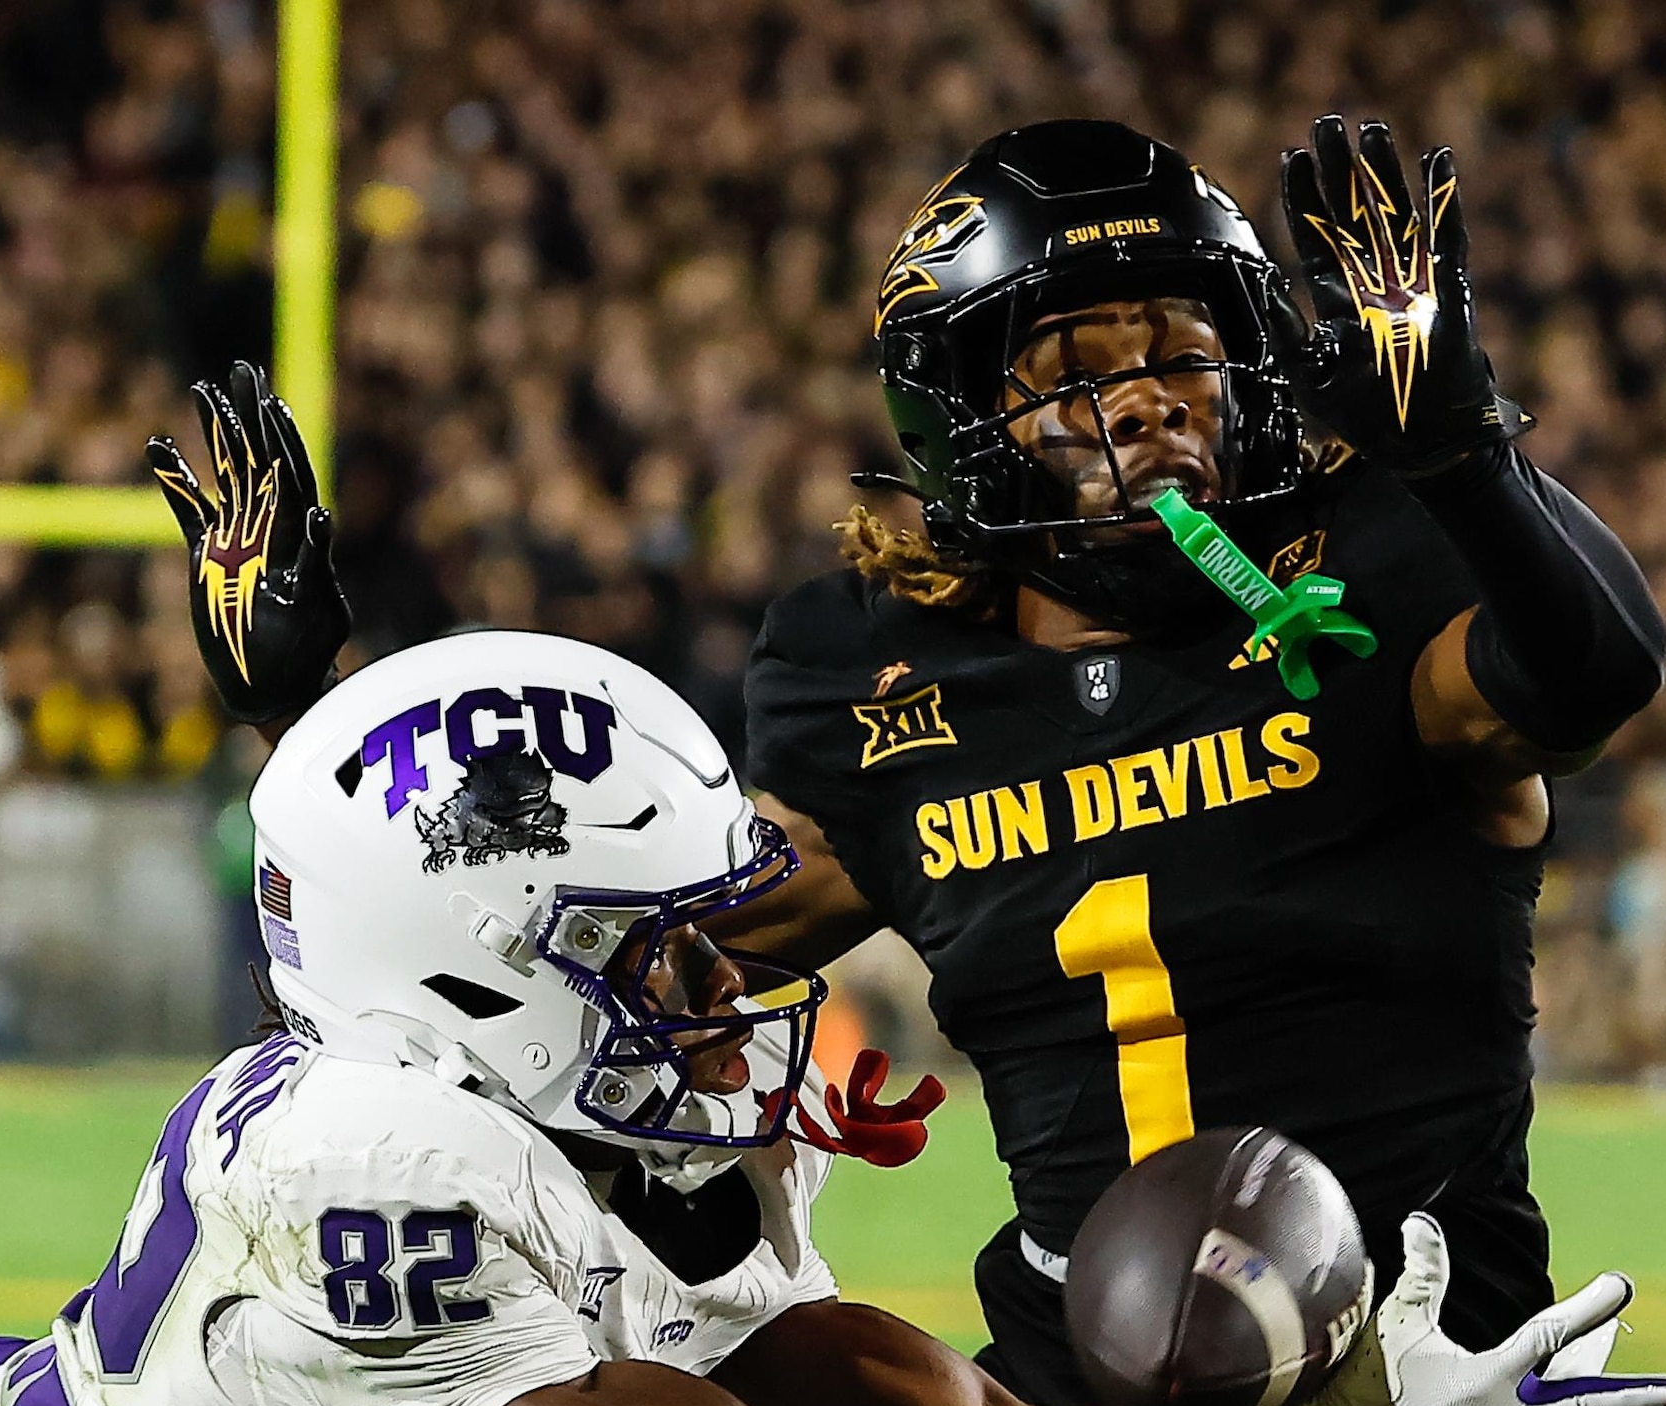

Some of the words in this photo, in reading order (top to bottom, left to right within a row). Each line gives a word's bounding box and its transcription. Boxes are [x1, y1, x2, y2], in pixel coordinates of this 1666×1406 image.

[1064, 224, 1102, 246] SUN
[1103, 217, 1162, 238] DEVILS
[1197, 536, 1274, 612] NXTRND
[1086, 662, 1106, 681] PT
[1090, 683, 1110, 701] 42
[361, 686, 618, 820] TCU
[915, 783, 1053, 881] SUN
[1063, 710, 1322, 844] DEVILS
[280, 1001, 324, 1045] OGS
[1054, 872, 1196, 1167] 1
[317, 1205, 495, 1330] 82
[656, 1318, 696, 1347] TCU
